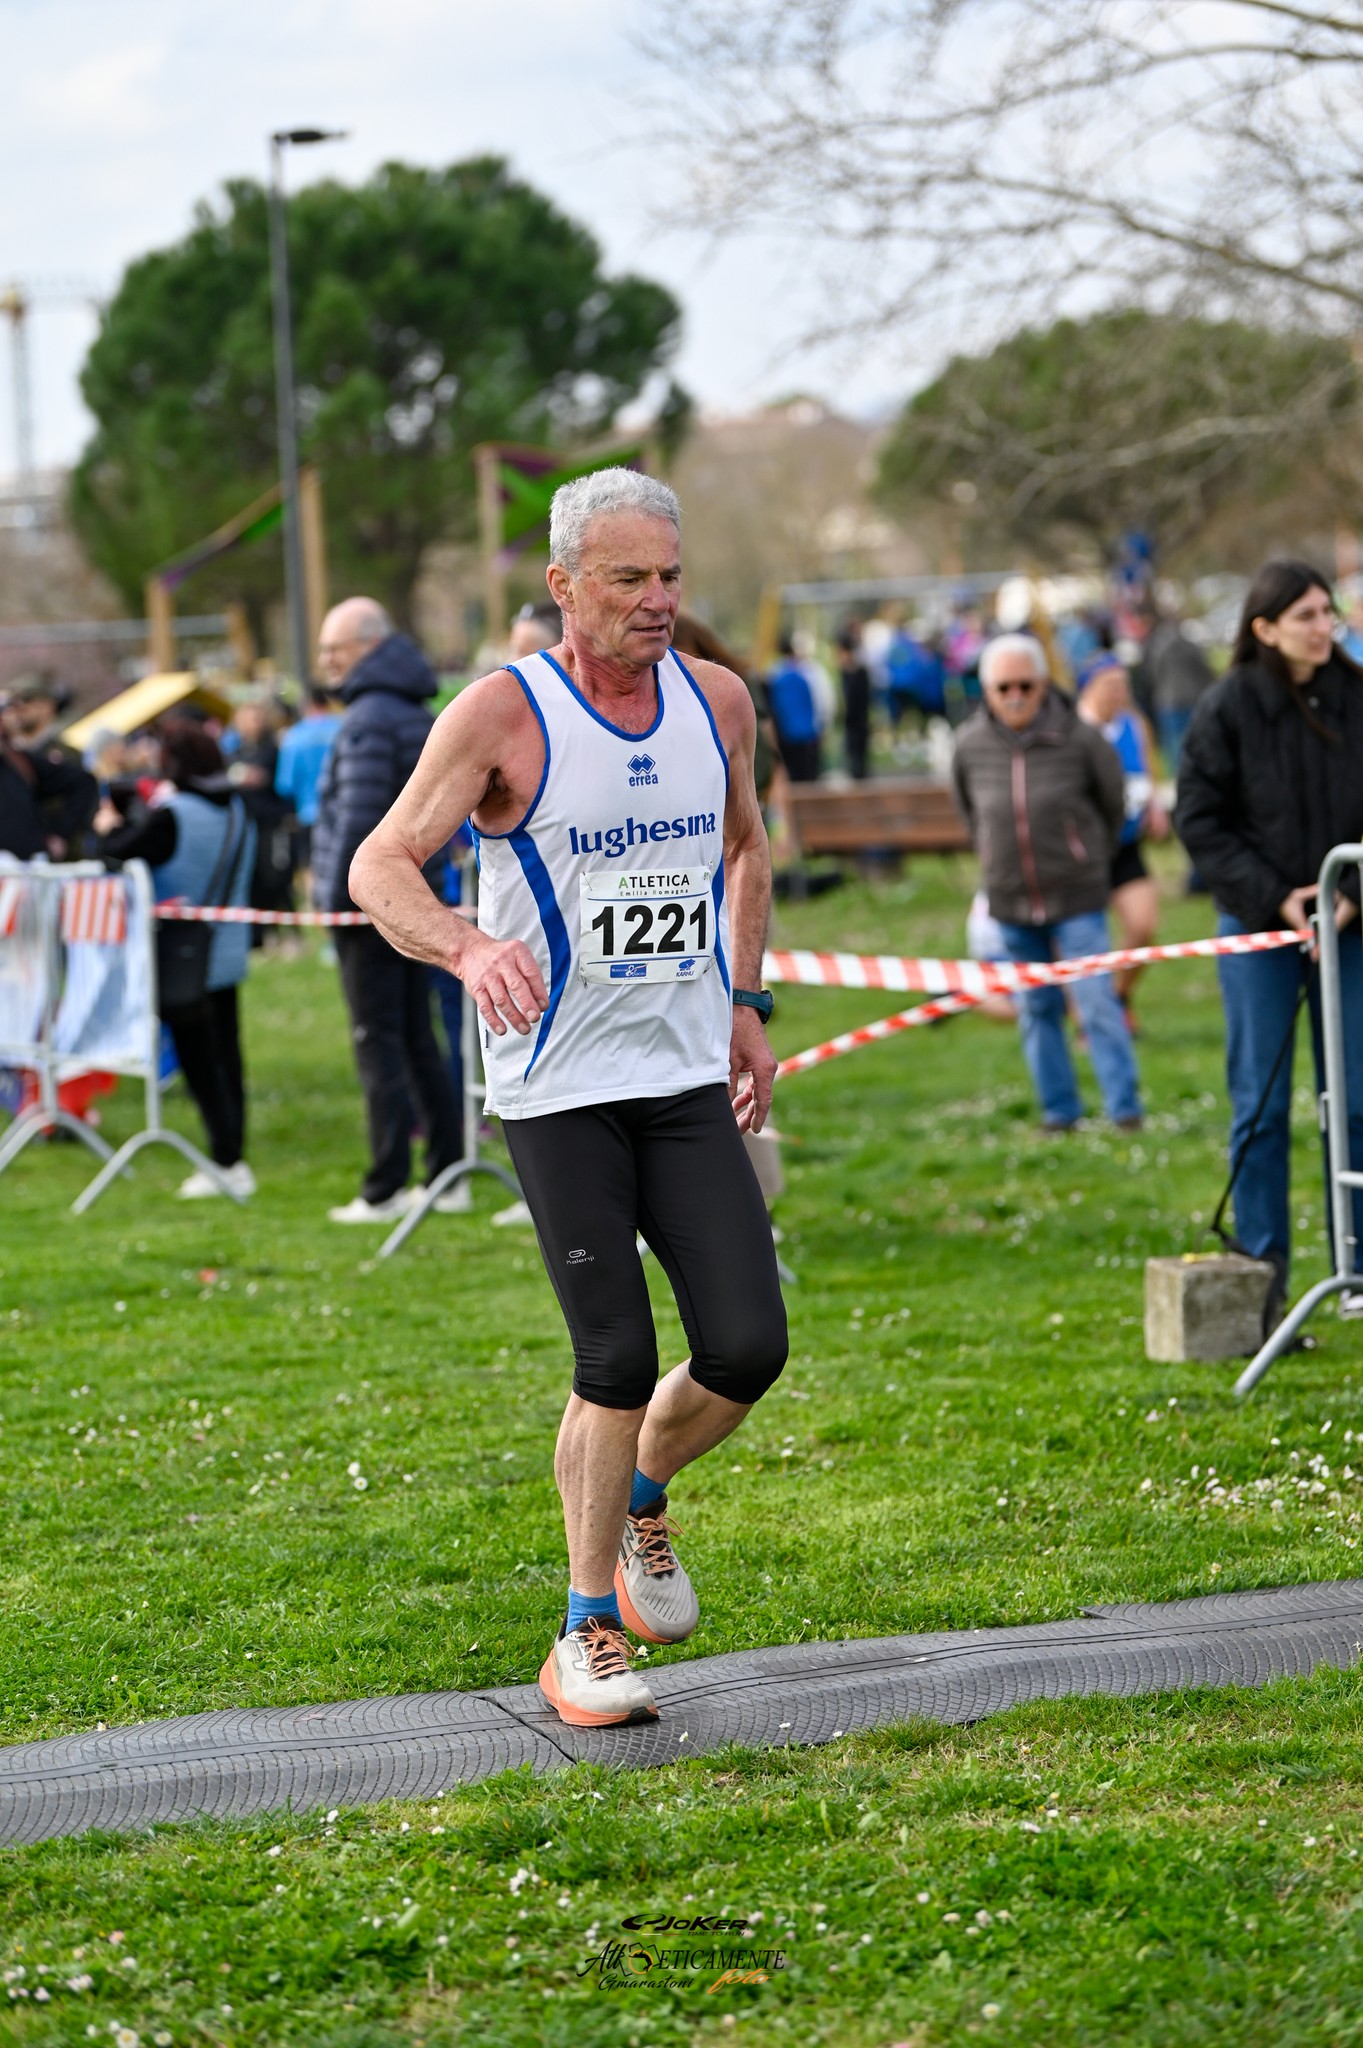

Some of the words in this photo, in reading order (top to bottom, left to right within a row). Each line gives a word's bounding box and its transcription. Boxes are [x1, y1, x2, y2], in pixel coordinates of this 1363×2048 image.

[568, 812, 716, 858] lughesina
[618, 874, 690, 889] ATLETICA
[592, 900, 707, 956] 1221
